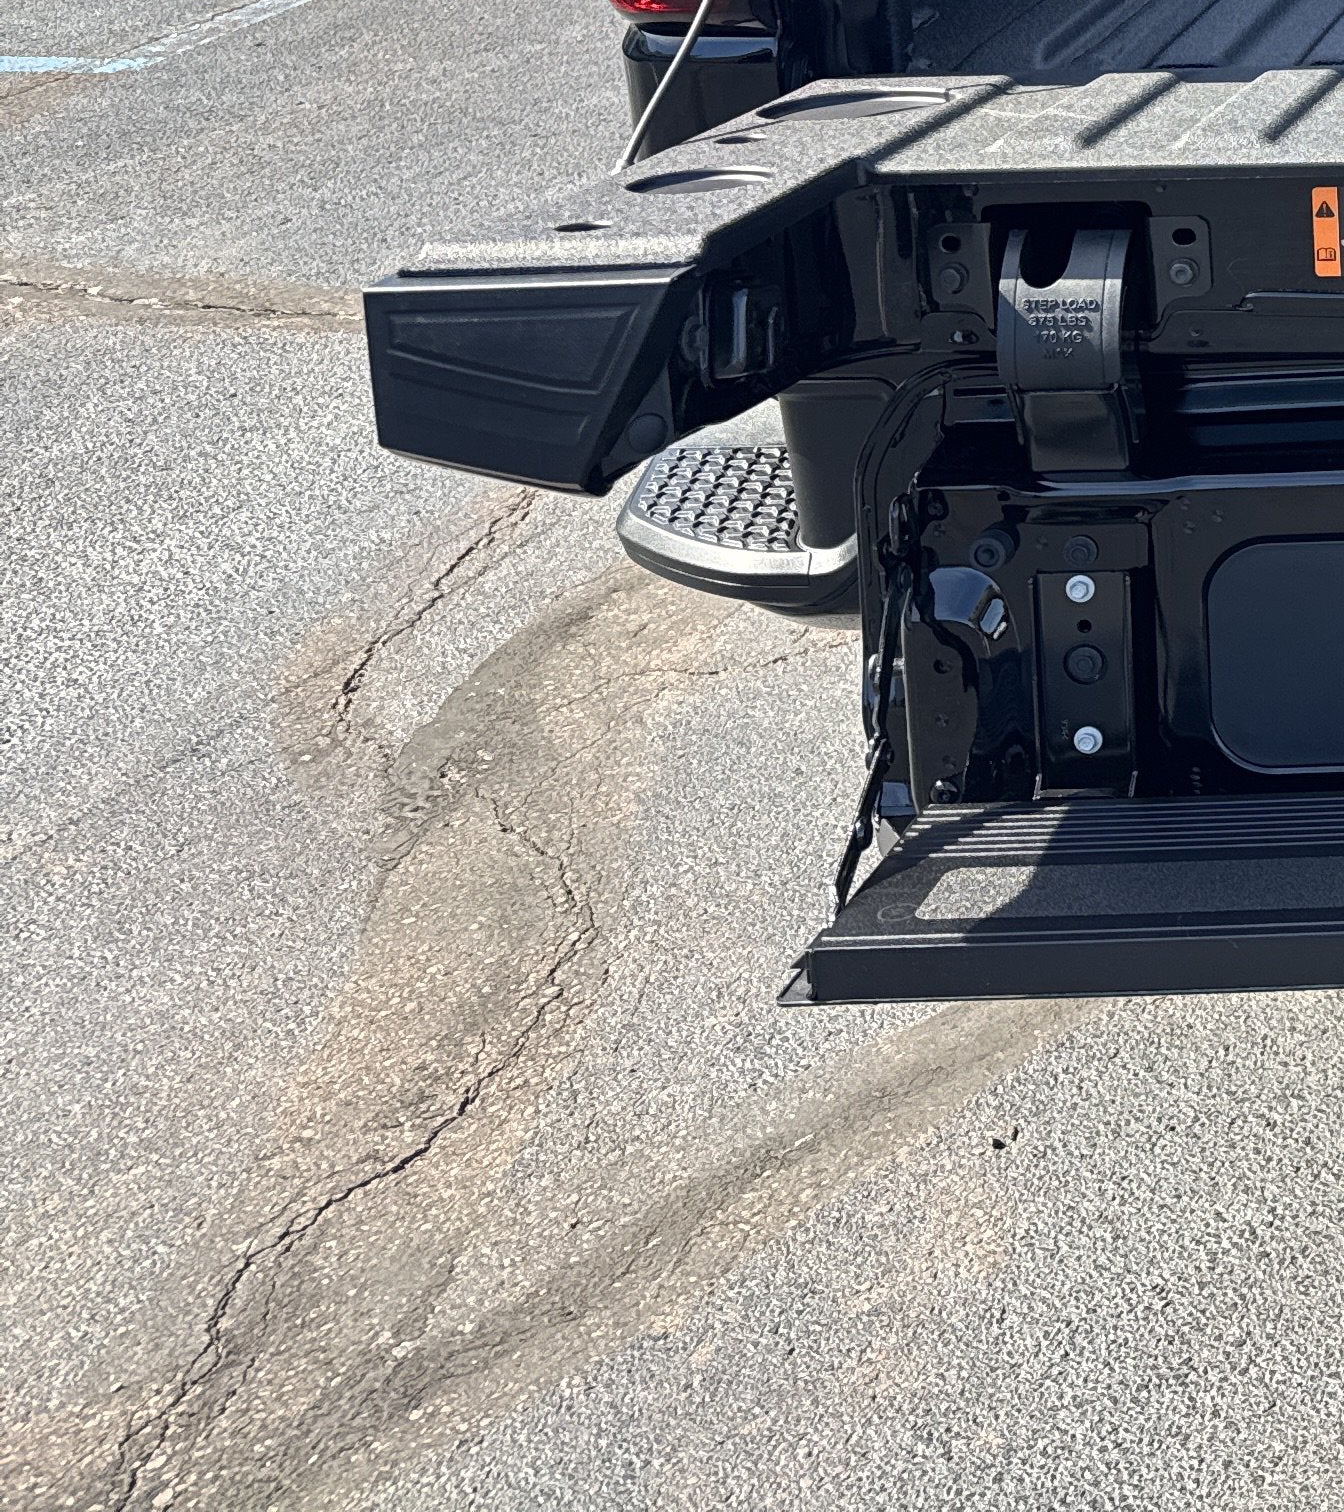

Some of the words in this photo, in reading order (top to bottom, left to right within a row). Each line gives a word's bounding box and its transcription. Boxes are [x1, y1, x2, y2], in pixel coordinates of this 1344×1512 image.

[1022, 297, 1056, 310] STEP
[1060, 297, 1097, 310] LOAD
[1058, 313, 1087, 326] LBS
[1062, 329, 1083, 343] KG
